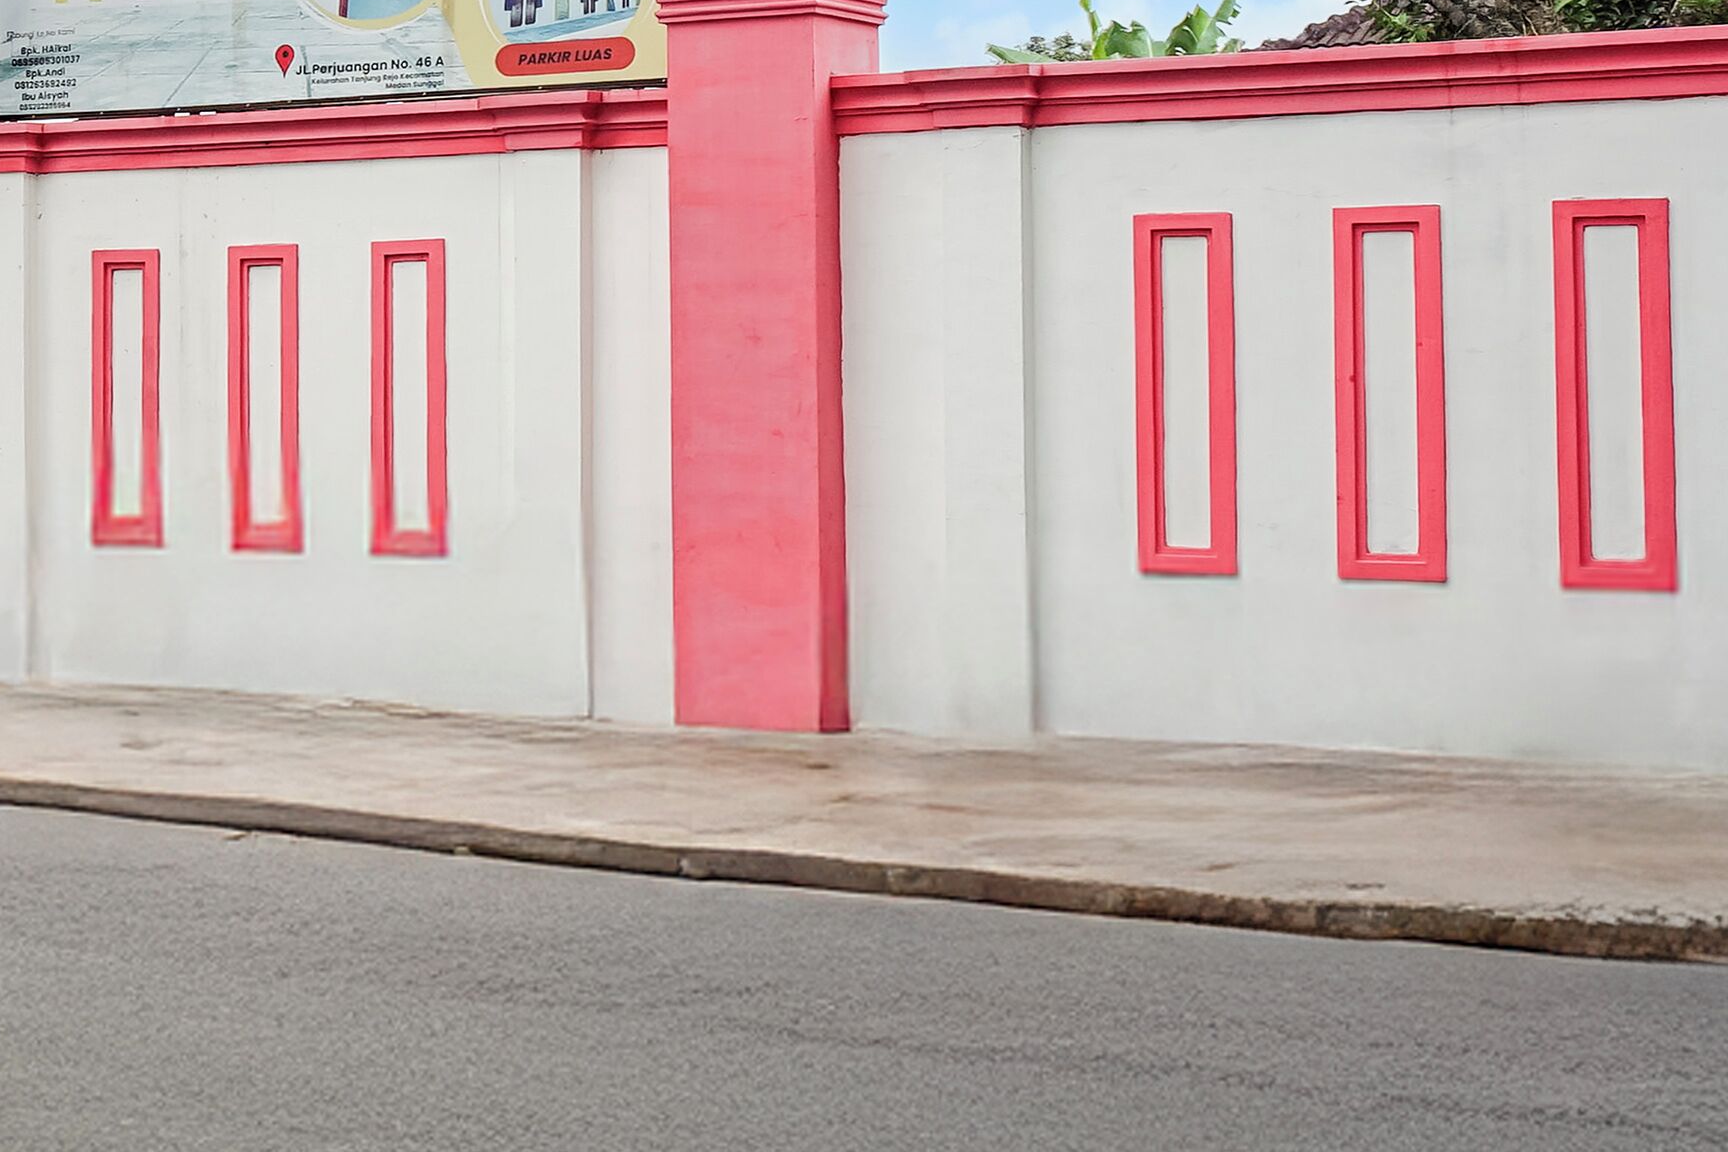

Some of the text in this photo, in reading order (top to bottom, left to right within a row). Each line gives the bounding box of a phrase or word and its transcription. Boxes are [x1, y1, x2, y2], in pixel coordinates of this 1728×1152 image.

[391, 59, 412, 70] No.
[415, 56, 431, 67] 46
[435, 56, 444, 66] A
[518, 48, 612, 66] PARKIR LUAS
